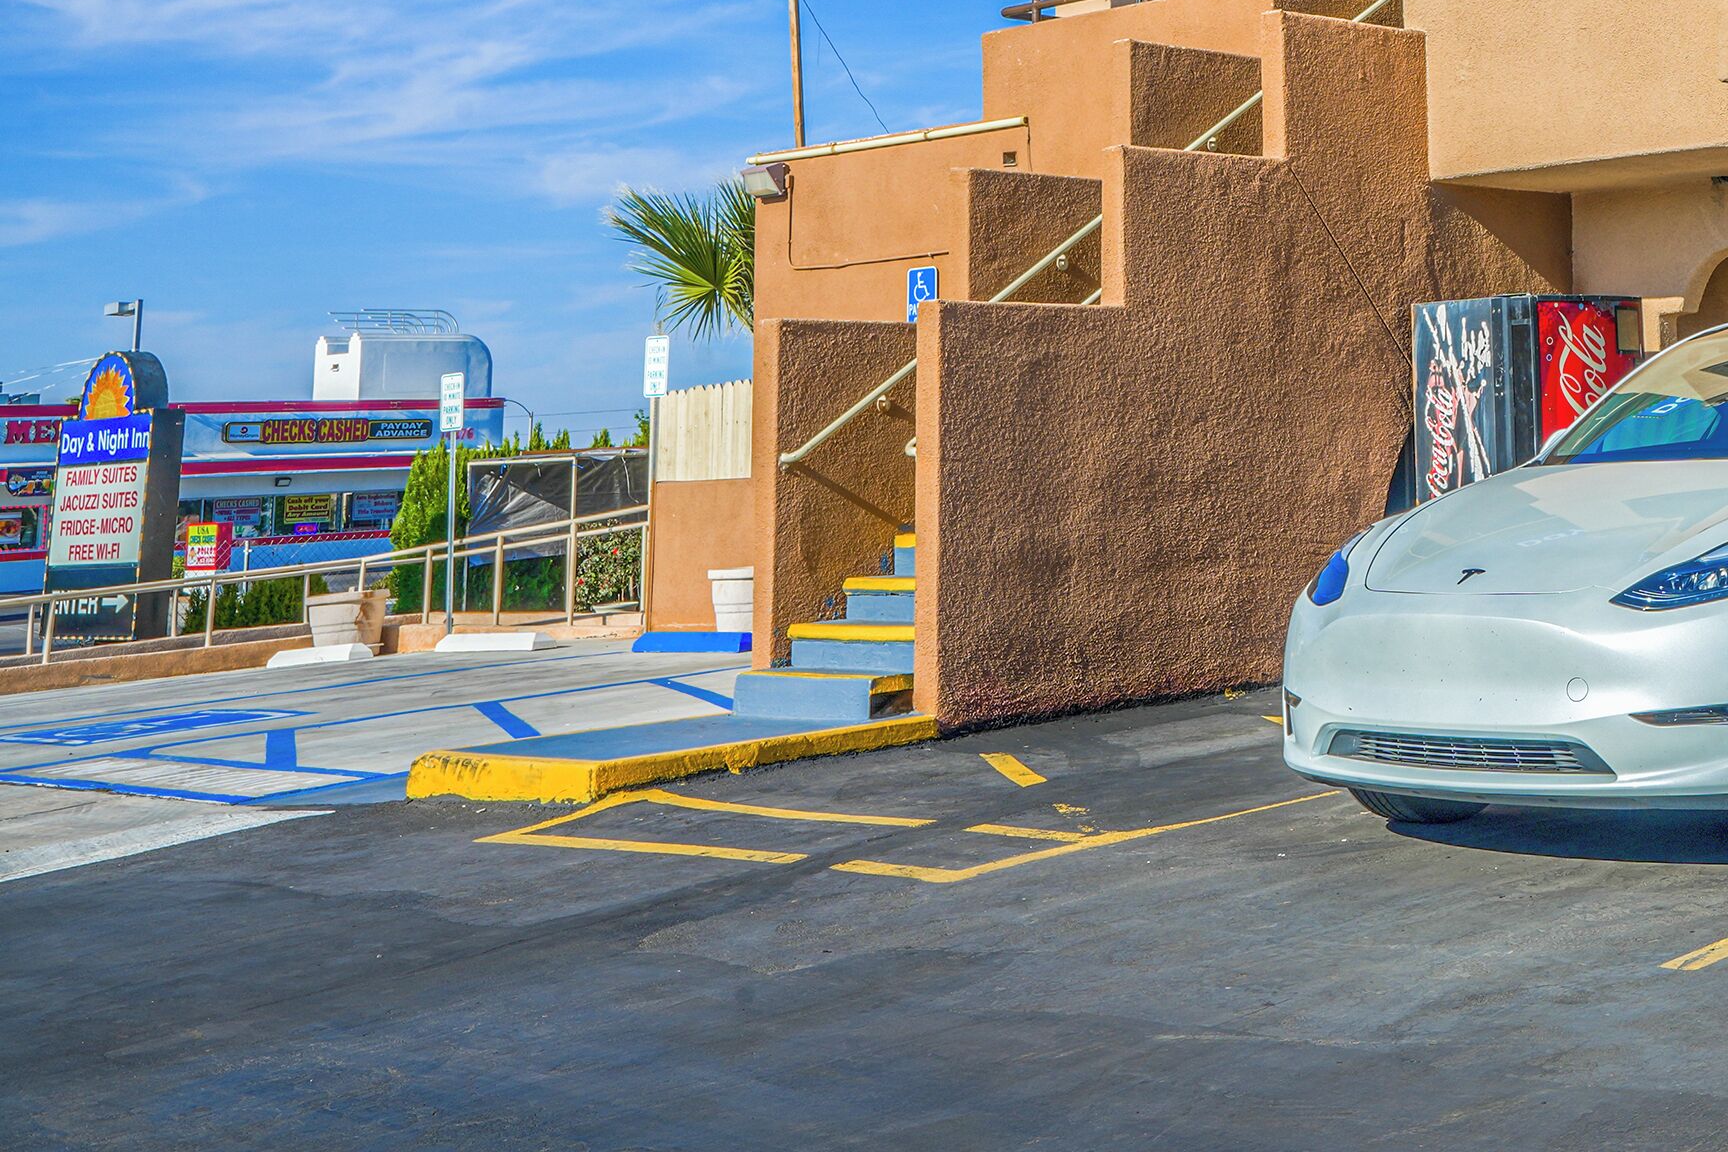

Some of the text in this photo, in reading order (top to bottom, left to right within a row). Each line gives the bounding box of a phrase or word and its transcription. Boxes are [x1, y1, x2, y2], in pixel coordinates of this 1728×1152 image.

[262, 419, 315, 442] CHECKS
[317, 418, 368, 442] CASHED
[375, 429, 428, 437] ADVANCE
[61, 428, 150, 458] Day & Night Inn
[66, 468, 100, 487] FAMILY
[101, 465, 138, 484] SUITES
[60, 490, 138, 512] JACUZZI SUITES
[216, 498, 260, 508] CHECKS CASHED
[68, 542, 120, 561] FREE WI-FI
